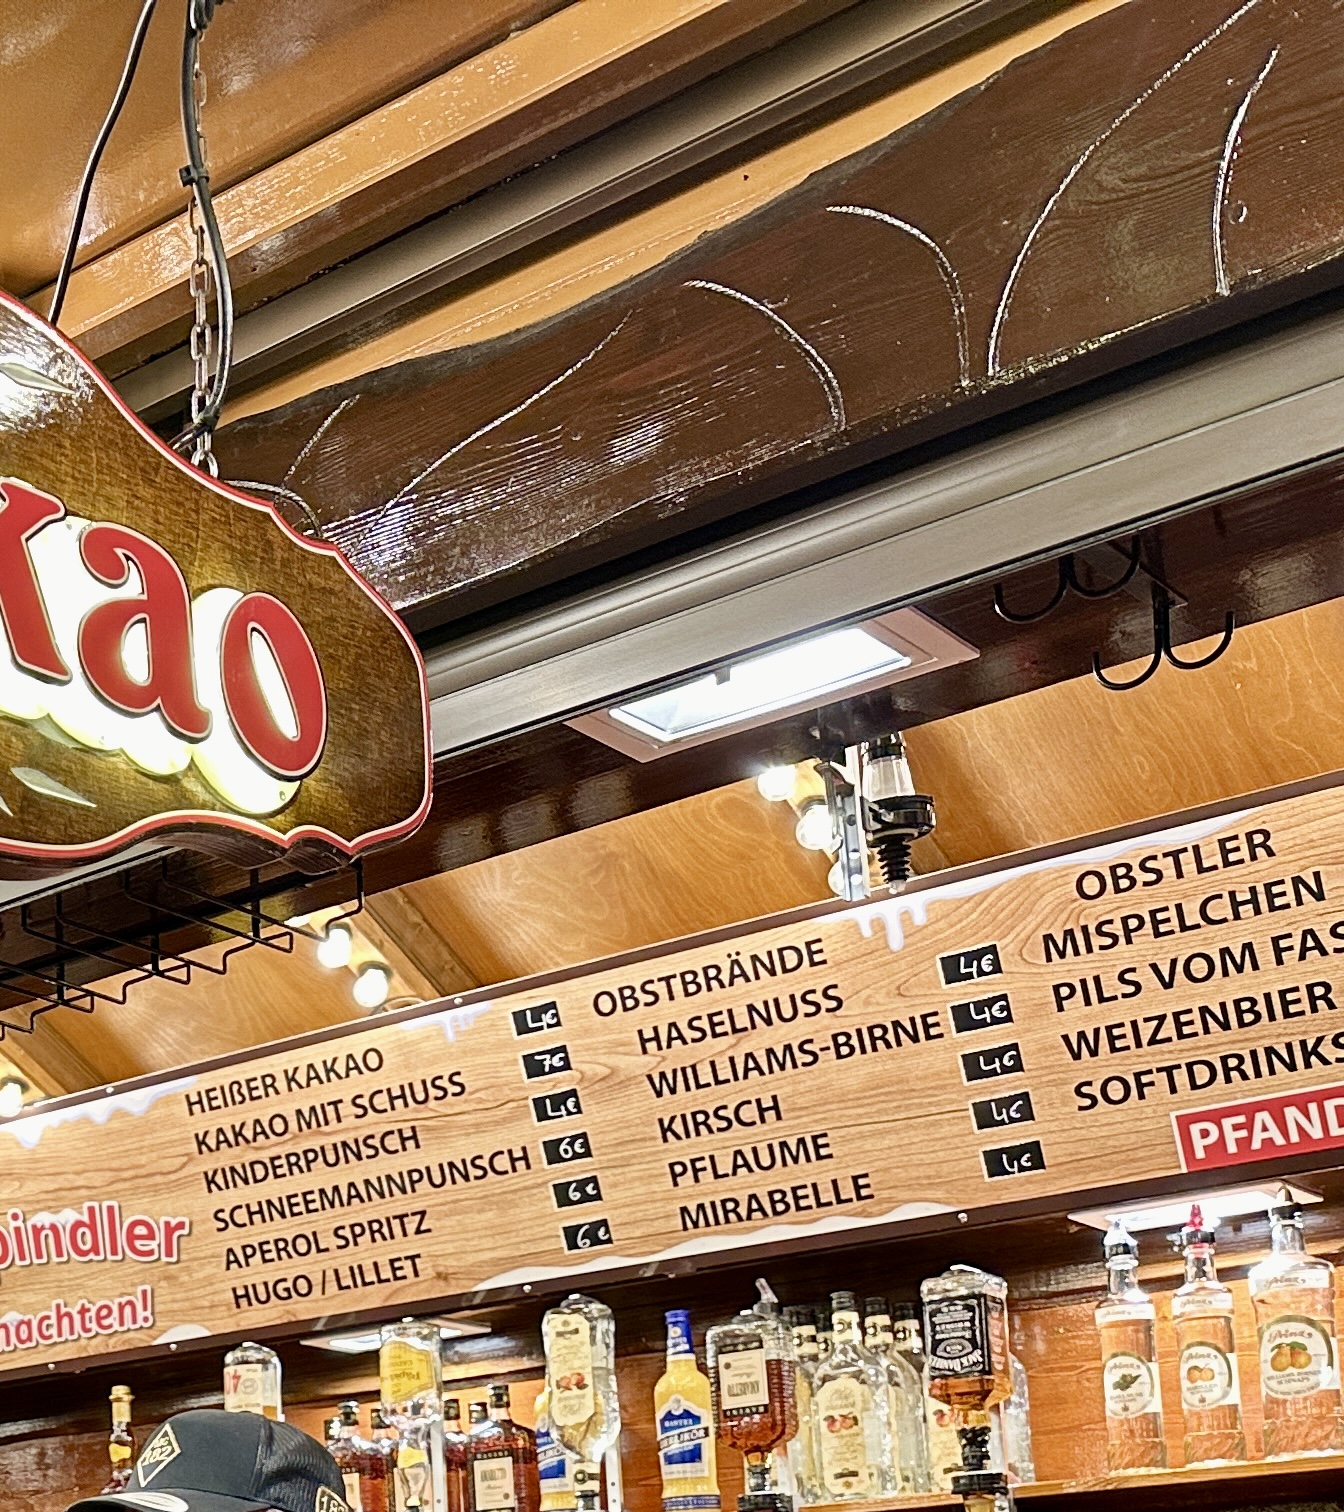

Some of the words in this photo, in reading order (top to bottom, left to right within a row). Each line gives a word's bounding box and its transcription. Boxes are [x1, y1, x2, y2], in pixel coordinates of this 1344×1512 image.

[1076, 829, 1276, 901] OBSTLER
[1043, 871, 1327, 963] MISPELCHEN
[593, 938, 828, 1017] OBSTBRÄNDE
[959, 954, 994, 976] 4€
[1052, 967, 1142, 1013] PILS
[1148, 943, 1260, 989] VOM
[637, 983, 843, 1055] HASELNUSS
[970, 1001, 1008, 1021] 4€
[1062, 980, 1338, 1061] WEIZENBIER
[186, 1070, 279, 1117] HEIßER
[283, 1047, 384, 1097] KAKAO
[536, 1052, 566, 1072] 7€
[646, 1011, 944, 1098] WILLIAMS-BIRNE
[979, 1051, 1016, 1073] 4€
[1073, 1031, 1344, 1111] SOFTDRINKS
[194, 1113, 290, 1156] KAKAO
[294, 1100, 347, 1135] MIT
[352, 1071, 467, 1119] SCHUSS
[658, 1094, 783, 1143] KIRSCH
[991, 1100, 1024, 1123] 4€
[1189, 1097, 1344, 1160] PFAND
[202, 1126, 421, 1194] KINDERPUNSCH
[559, 1138, 585, 1158] 6€
[668, 1132, 834, 1187] PFLAUME
[1001, 1153, 1033, 1174] 4€
[213, 1146, 532, 1232] SCHNEEMANNPUNSCH
[568, 1183, 598, 1200] 6€
[679, 1173, 875, 1231] MIRABELLE
[224, 1229, 330, 1272] APEROL
[333, 1210, 432, 1255] SPRITZ
[576, 1227, 609, 1249] 6€
[231, 1274, 313, 1309] HUGO
[334, 1254, 421, 1291] LILLET
